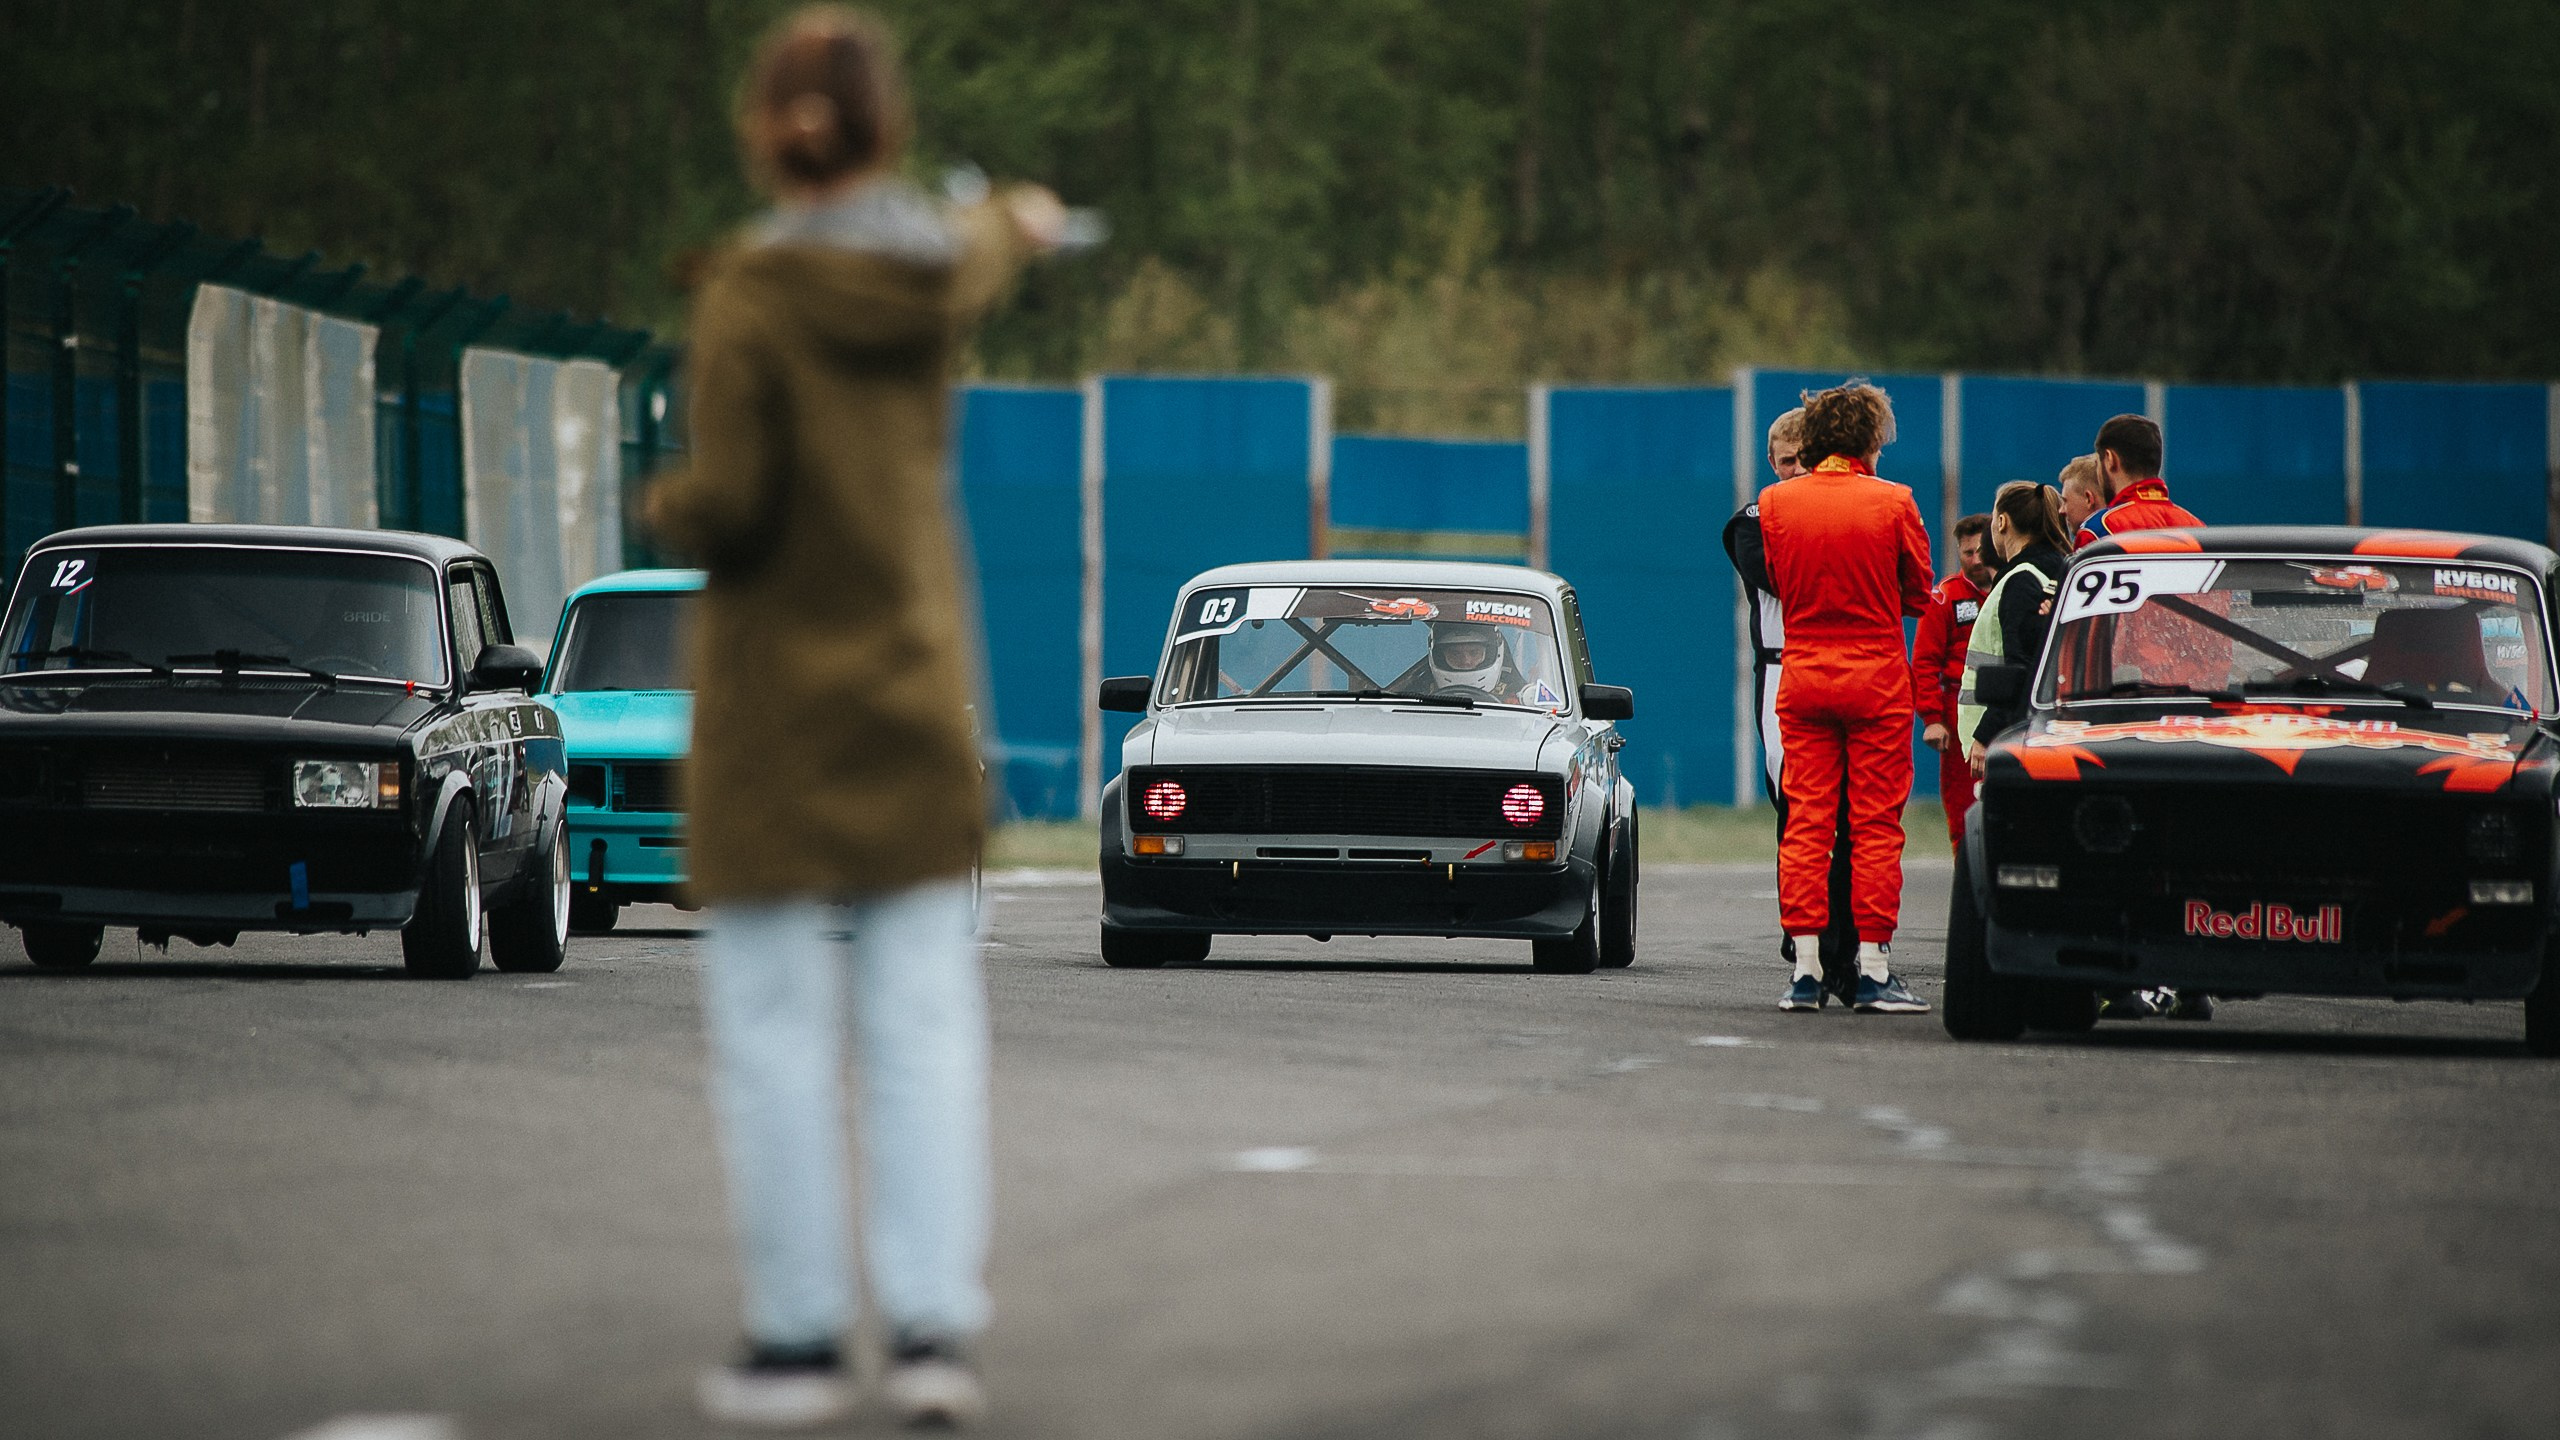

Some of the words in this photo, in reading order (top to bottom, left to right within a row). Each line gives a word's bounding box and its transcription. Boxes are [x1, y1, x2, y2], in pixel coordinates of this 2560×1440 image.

[50, 559, 86, 588] 12
[2433, 569, 2518, 595] КУБОК
[2076, 569, 2142, 608] 95
[1199, 597, 1237, 625] 03
[1465, 600, 1532, 619] КУБОК
[1465, 613, 1531, 627] КЛАССИКИ
[2184, 900, 2262, 940] Red
[2266, 903, 2343, 944] Bull
